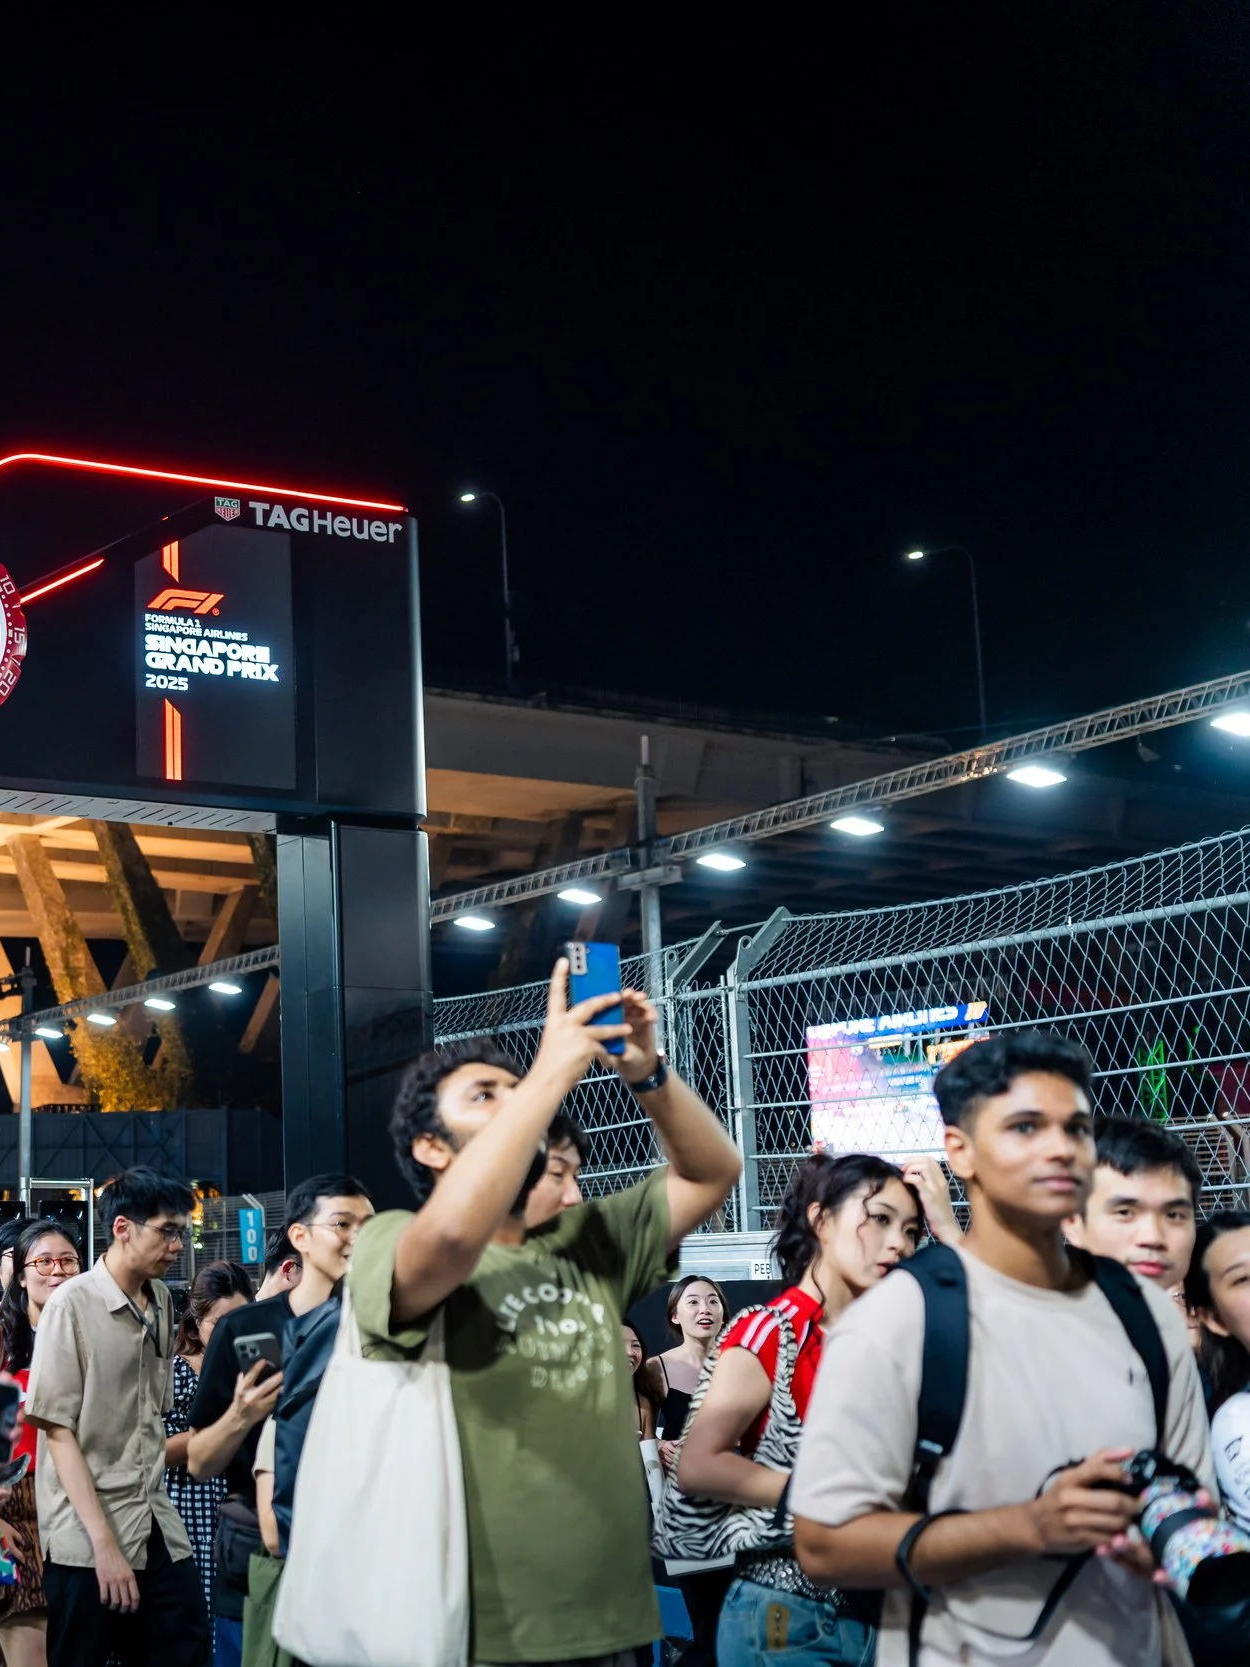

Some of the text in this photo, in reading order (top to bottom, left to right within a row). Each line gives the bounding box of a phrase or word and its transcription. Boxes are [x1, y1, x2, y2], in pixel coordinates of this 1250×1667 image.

[217, 498, 238, 508] TAG
[215, 506, 240, 519] HEUER
[0, 574, 16, 595] 10
[144, 613, 202, 628] FORMULA 1
[14, 626, 26, 644] 15
[144, 622, 249, 641] SINGAPORE AIRLINES
[144, 633, 271, 663] SINGAPORE
[144, 651, 280, 682] GRAND PRIX
[145, 673, 189, 691] 2025
[246, 1211, 258, 1262] 100
